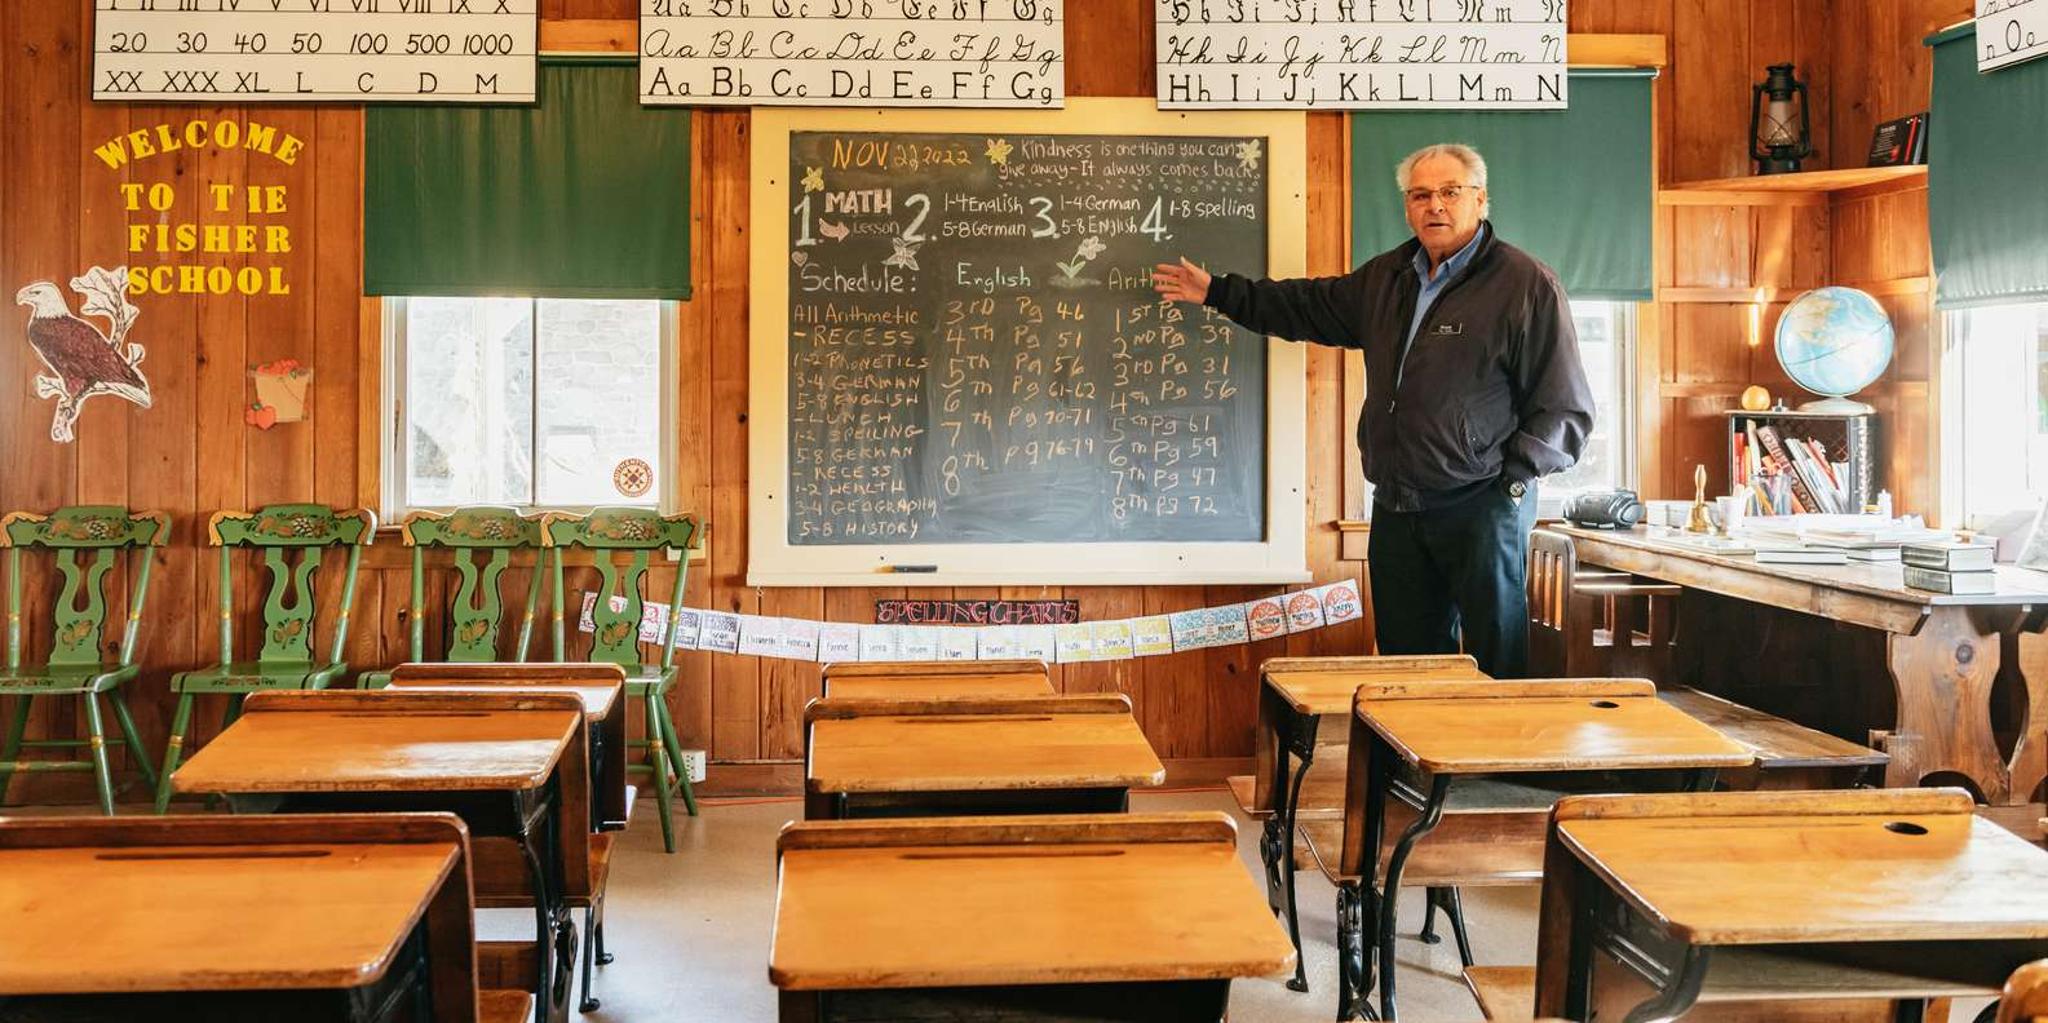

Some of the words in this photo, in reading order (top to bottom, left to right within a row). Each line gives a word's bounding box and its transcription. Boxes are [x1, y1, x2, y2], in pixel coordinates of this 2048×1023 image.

[110, 32, 147, 53] 20
[176, 32, 207, 53] 30
[234, 32, 267, 54] 40
[291, 32, 322, 54] 50
[350, 33, 388, 54] 100
[405, 34, 450, 55] 500
[464, 33, 513, 55] 1000
[1541, 34, 1561, 63] N
[103, 70, 144, 93] XX
[161, 71, 220, 93] XXX
[234, 71, 270, 93] XL
[297, 72, 313, 93] L
[358, 72, 374, 94] C
[418, 72, 438, 94] D
[475, 73, 498, 94] M
[1538, 74, 1561, 101] N
[94, 120, 304, 170] WELCOME
[1021, 138, 1092, 160] Kindness
[1101, 140, 1111, 156] is
[1180, 143, 1205, 157] you
[998, 162, 1026, 180] give
[1103, 161, 1152, 177] always
[1160, 164, 1208, 177] comes
[121, 183, 174, 211] TO
[824, 188, 892, 215] MATH
[969, 193, 1023, 214] English
[1060, 194, 1083, 210] 1-4
[1085, 194, 1141, 211] German
[1170, 200, 1191, 218] 1-8
[942, 221, 970, 238] 5-8
[972, 221, 1026, 238] German
[1061, 218, 1085, 235] 5-8
[129, 224, 292, 253] FISHER
[128, 266, 290, 295] SCHOOL
[958, 262, 1031, 294] English
[794, 304, 818, 323] All
[826, 303, 920, 325] Arithmetic
[1016, 296, 1043, 323] Pg
[1057, 302, 1084, 320] 46
[814, 325, 915, 346] RECESS
[1015, 325, 1040, 349] Pg
[1058, 331, 1082, 349] 51
[1200, 325, 1231, 345] 39
[1053, 354, 1085, 377] 56
[1202, 356, 1228, 375] 31
[1012, 375, 1040, 401] Pg
[1204, 379, 1237, 400] 56
[835, 394, 918, 408] ENGLISH
[1189, 411, 1210, 432] 61
[1189, 437, 1217, 458] 59
[815, 466, 892, 480] RECESS
[1192, 467, 1216, 486] 47
[830, 480, 905, 496] HEALTH
[1189, 496, 1218, 513] 72
[846, 519, 918, 539] HISTORY
[878, 600, 988, 623] SPELLING
[990, 600, 1078, 623] CHARTS
